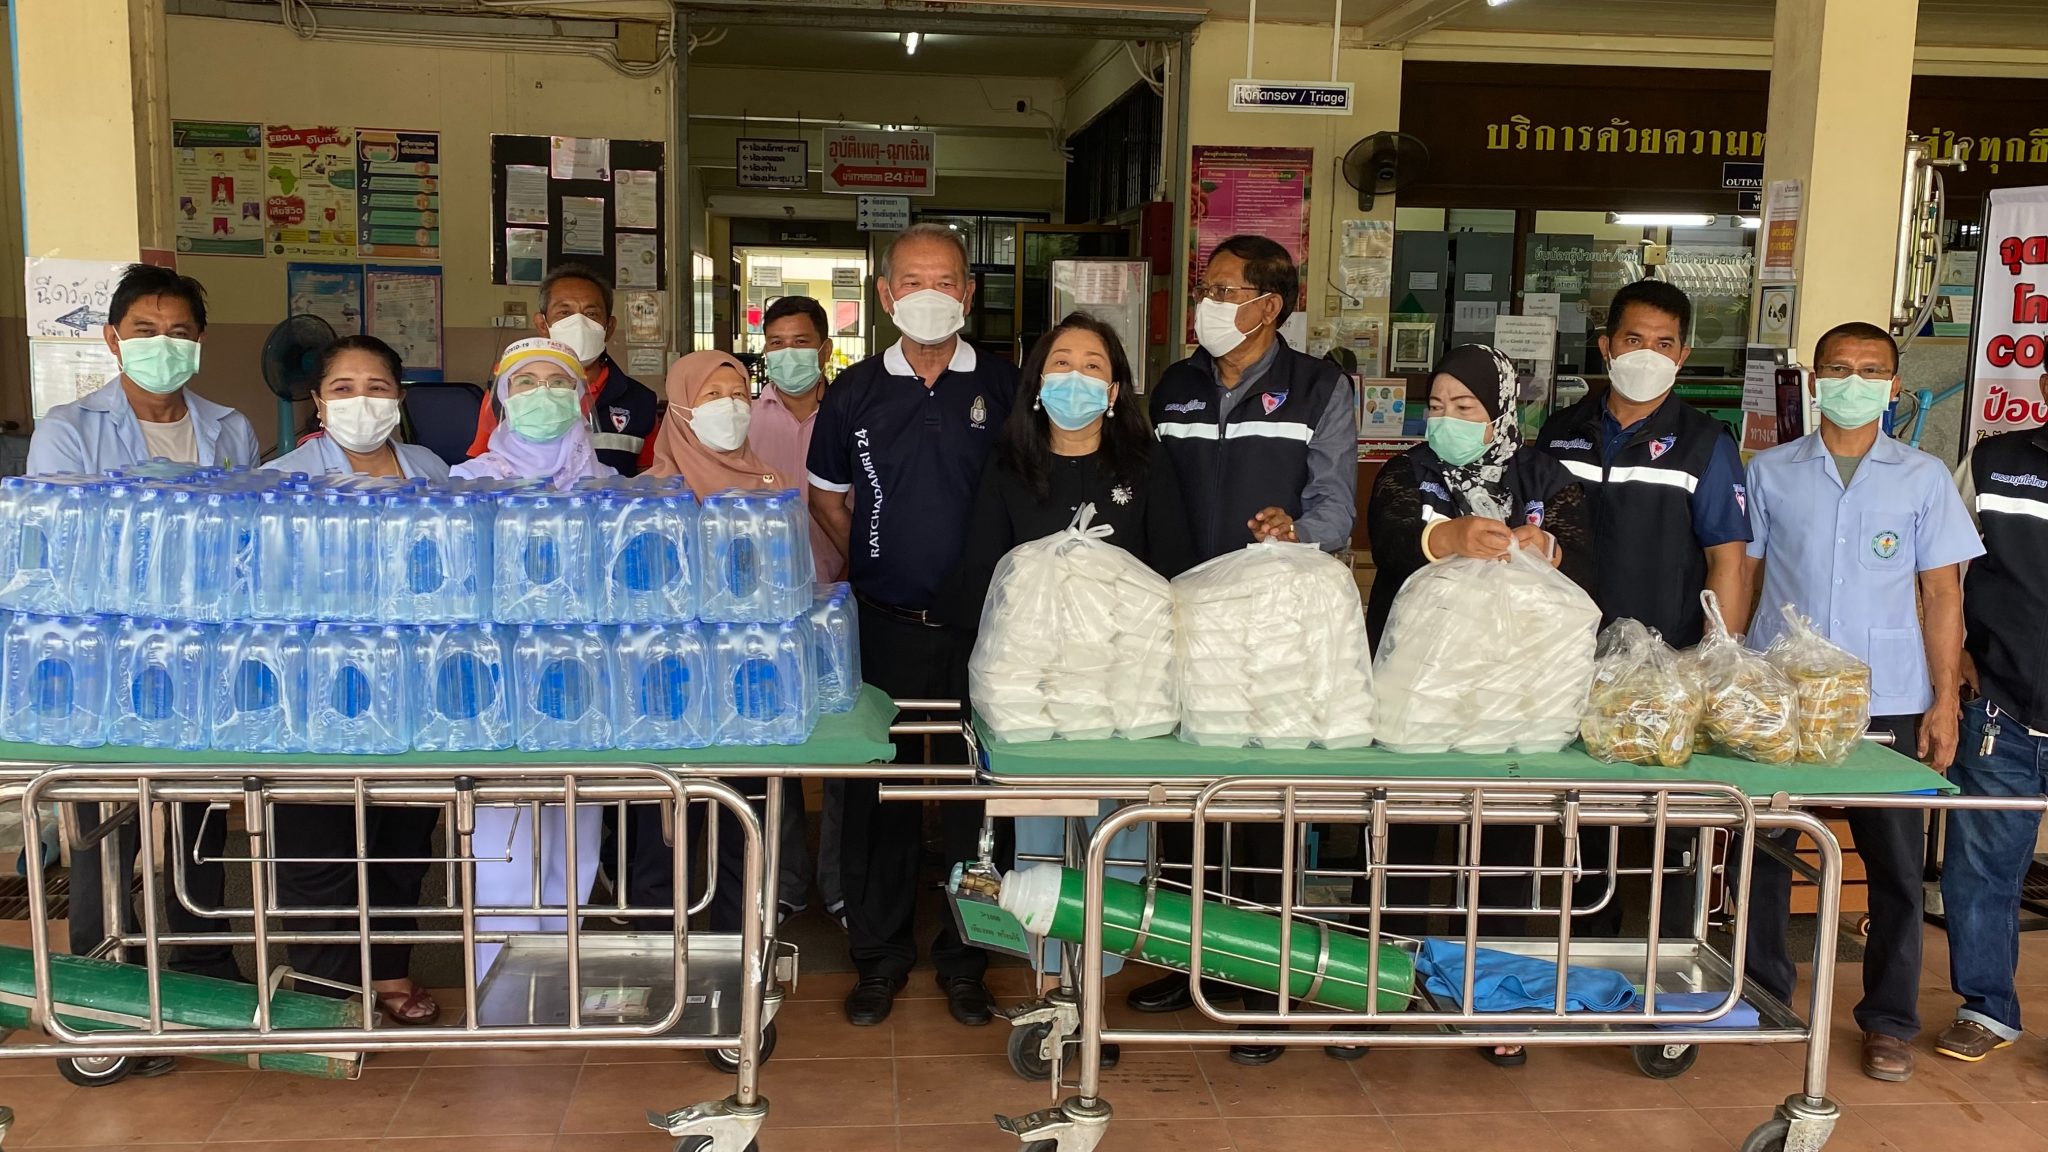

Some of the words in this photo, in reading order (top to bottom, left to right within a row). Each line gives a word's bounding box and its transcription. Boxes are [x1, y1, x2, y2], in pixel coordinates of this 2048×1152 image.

[1309, 91, 1345, 105] Triage
[269, 134, 301, 143] EBOLA
[829, 135, 930, 166] อุบัติเหตุ-ฉุกเฉิน
[362, 163, 368, 171] 1
[884, 172, 903, 183] 24
[360, 179, 368, 188] 2
[361, 195, 368, 204] 3
[361, 212, 369, 222] 4
[361, 230, 368, 240] 5
[34, 275, 115, 306] ฉีดวัคซี
[70, 329, 80, 337] 19
[1986, 334, 2048, 369] CO
[854, 428, 870, 449] 24
[859, 452, 883, 558] RATCHADAMRI
